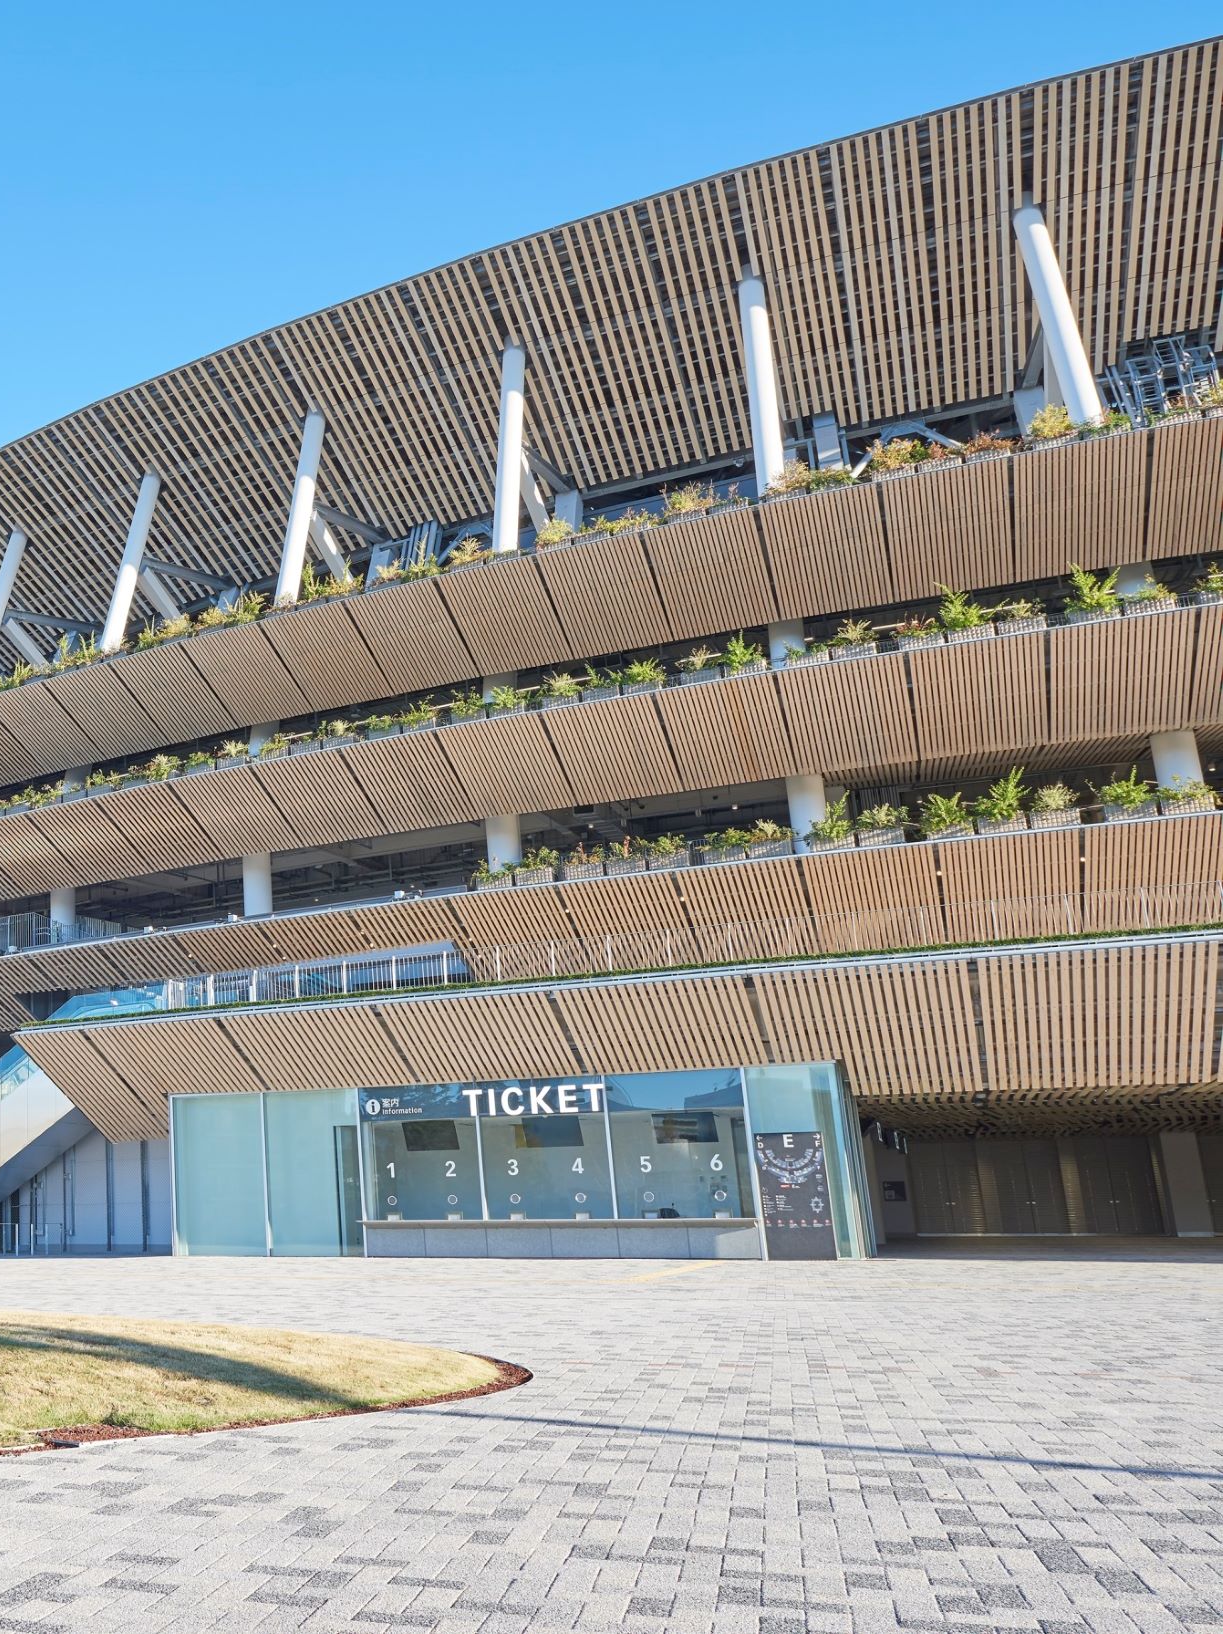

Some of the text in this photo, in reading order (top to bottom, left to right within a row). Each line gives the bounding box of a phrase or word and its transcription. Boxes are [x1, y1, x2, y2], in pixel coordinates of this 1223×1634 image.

[382, 1098, 399, 1107] 案内
[462, 1083, 605, 1117] TICKET
[757, 1141, 764, 1149] D
[782, 1133, 795, 1148] E
[814, 1140, 821, 1148] F
[386, 1162, 396, 1179] 1
[444, 1160, 457, 1177] 2
[507, 1158, 519, 1176] 3
[571, 1157, 584, 1174] 4
[639, 1155, 652, 1173] 5
[709, 1153, 723, 1171] 6
